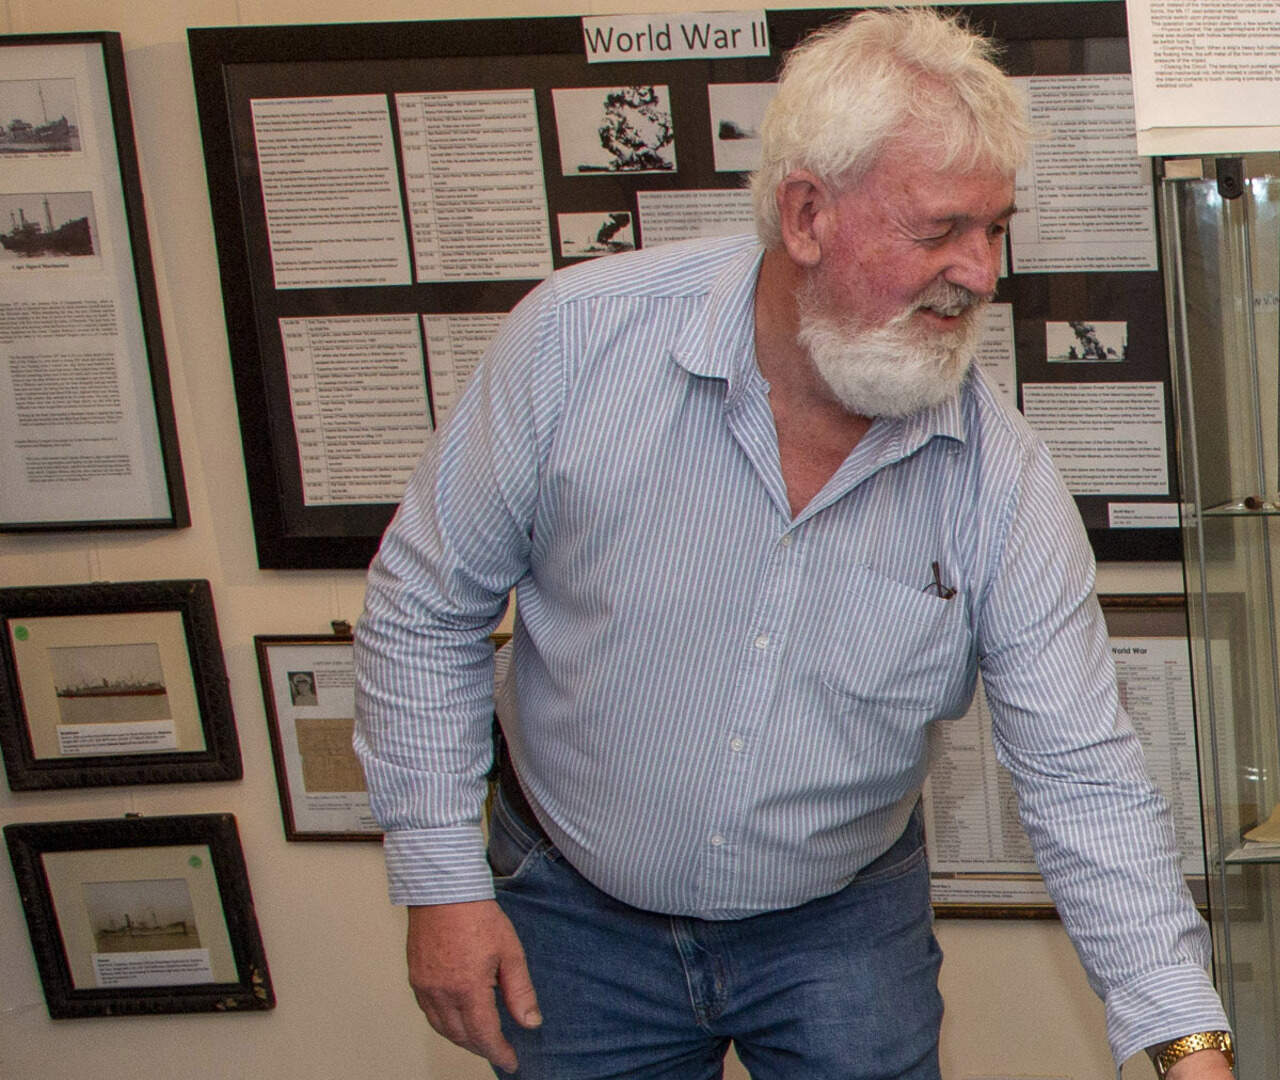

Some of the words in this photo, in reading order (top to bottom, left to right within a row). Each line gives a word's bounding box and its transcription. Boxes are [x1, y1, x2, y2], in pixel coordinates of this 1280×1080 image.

[585, 23, 672, 53] World
[681, 23, 742, 50] War
[752, 21, 767, 48] II
[1132, 647, 1148, 655] War
